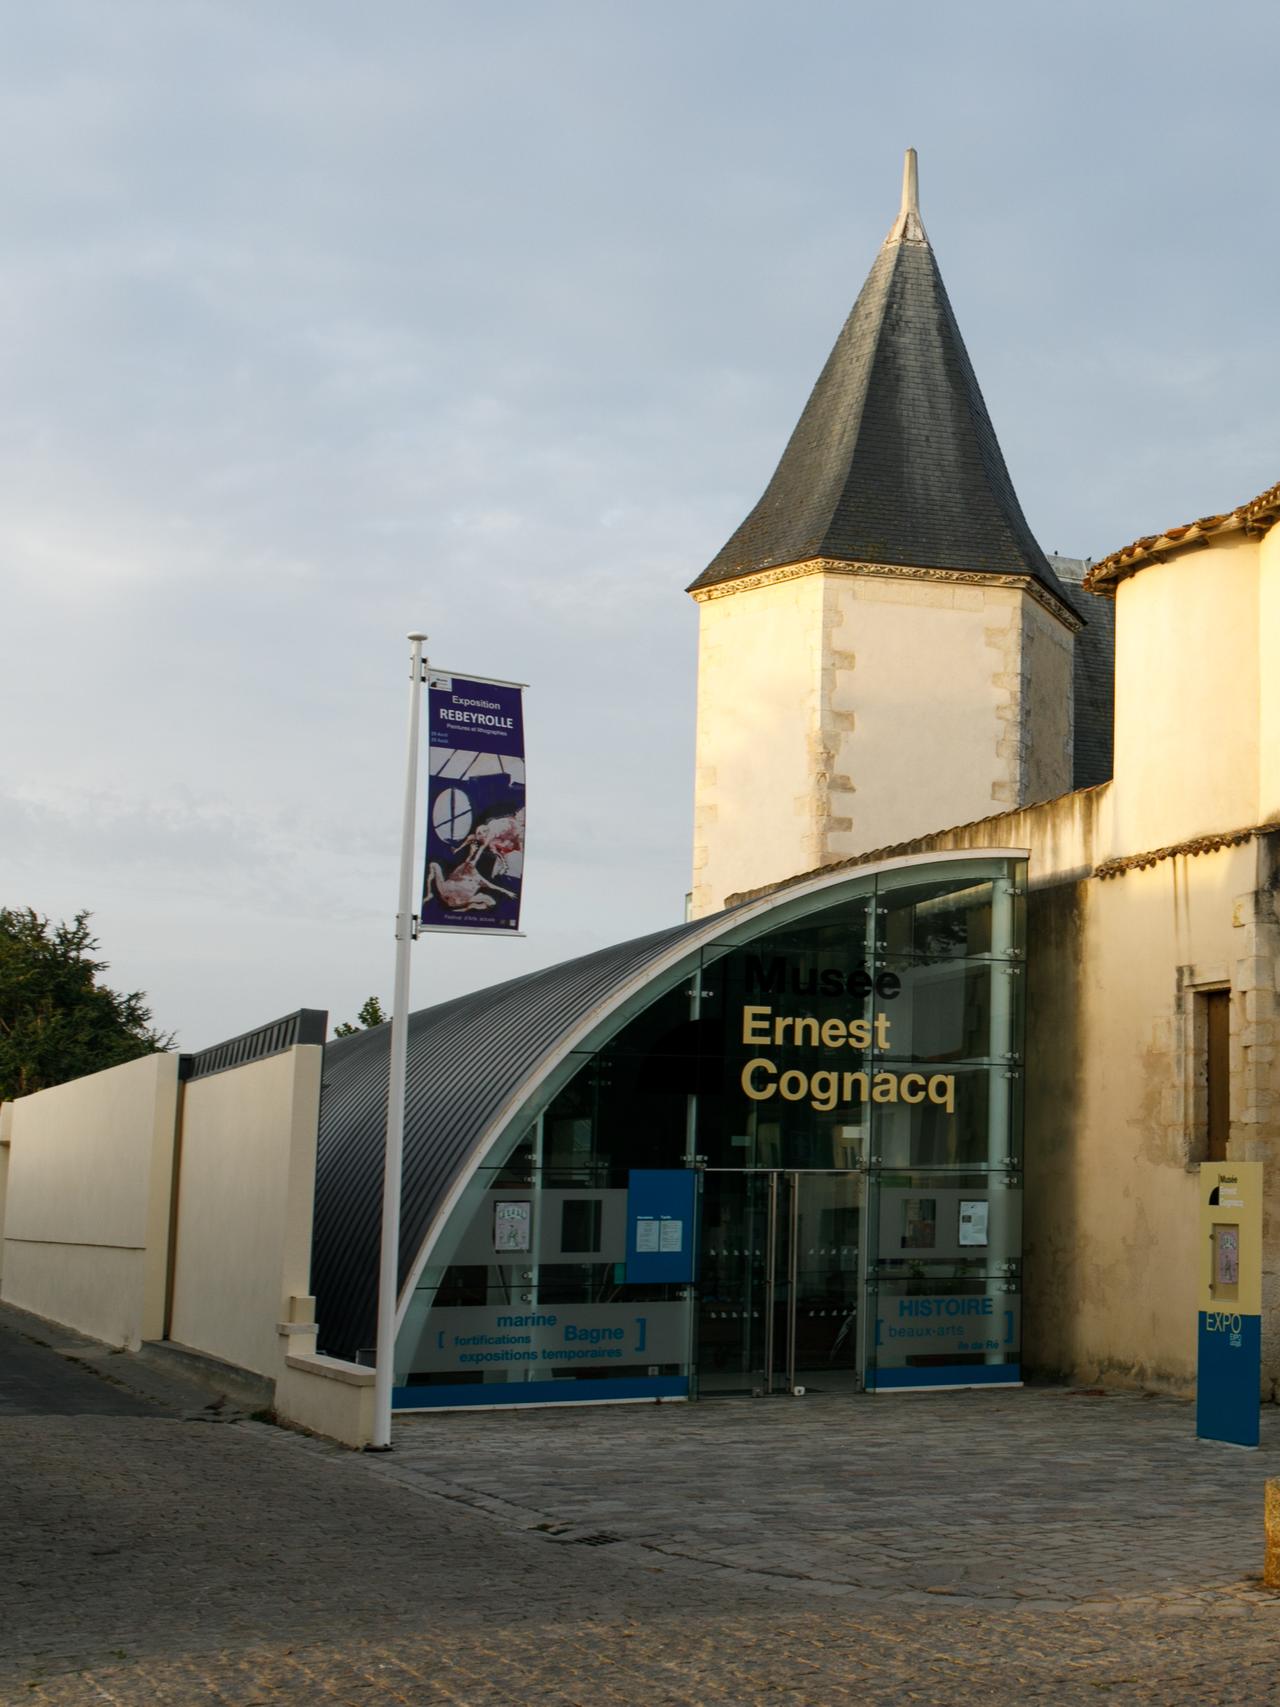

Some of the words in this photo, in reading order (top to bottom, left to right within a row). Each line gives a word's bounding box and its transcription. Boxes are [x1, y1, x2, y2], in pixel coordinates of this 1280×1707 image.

[452, 695, 501, 710] Exposition
[440, 708, 513, 729] REBEYROLLE
[745, 954, 902, 1000] Musée
[742, 1005, 891, 1049] Ernest
[741, 1058, 955, 1113] Cognacq
[898, 1297, 993, 1317] HISTOIRE
[496, 1312, 557, 1328] marine
[1206, 1311, 1242, 1334] EXPO
[454, 1334, 531, 1347] fortifications
[563, 1324, 625, 1344] Bagne
[459, 1350, 538, 1364] expositions
[541, 1347, 623, 1362] temporaires
